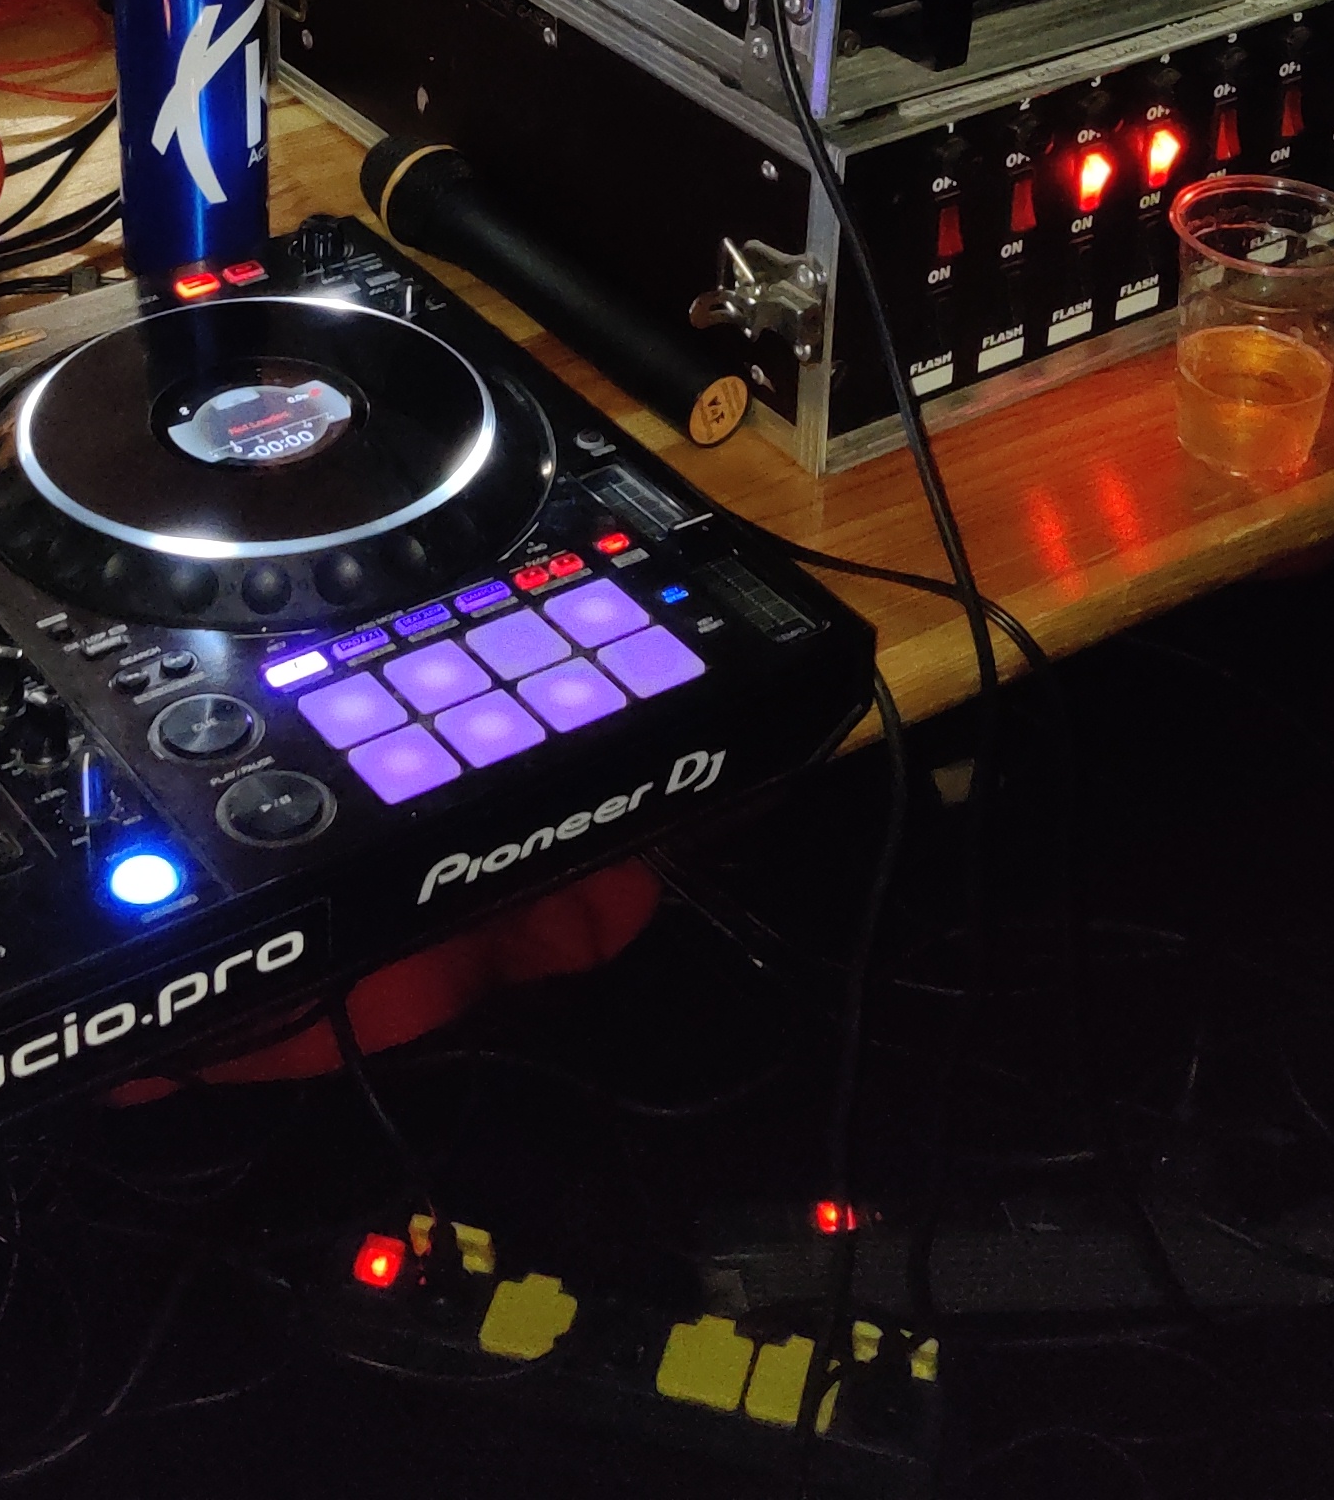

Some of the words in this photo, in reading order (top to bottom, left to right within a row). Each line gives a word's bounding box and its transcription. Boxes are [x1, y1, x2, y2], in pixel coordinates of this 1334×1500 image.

[1270, 147, 1290, 164] ON
[1139, 191, 1161, 209] ON
[1071, 215, 1093, 233] ON
[1001, 240, 1023, 258] ON
[927, 265, 951, 284] ON
[1119, 274, 1159, 298] FLASH
[1052, 299, 1092, 323] FLASH
[982, 324, 1024, 349] FLASH
[909, 352, 953, 376] FLASH
[416, 780, 654, 905] Pioneer
[664, 749, 727, 795] DJ
